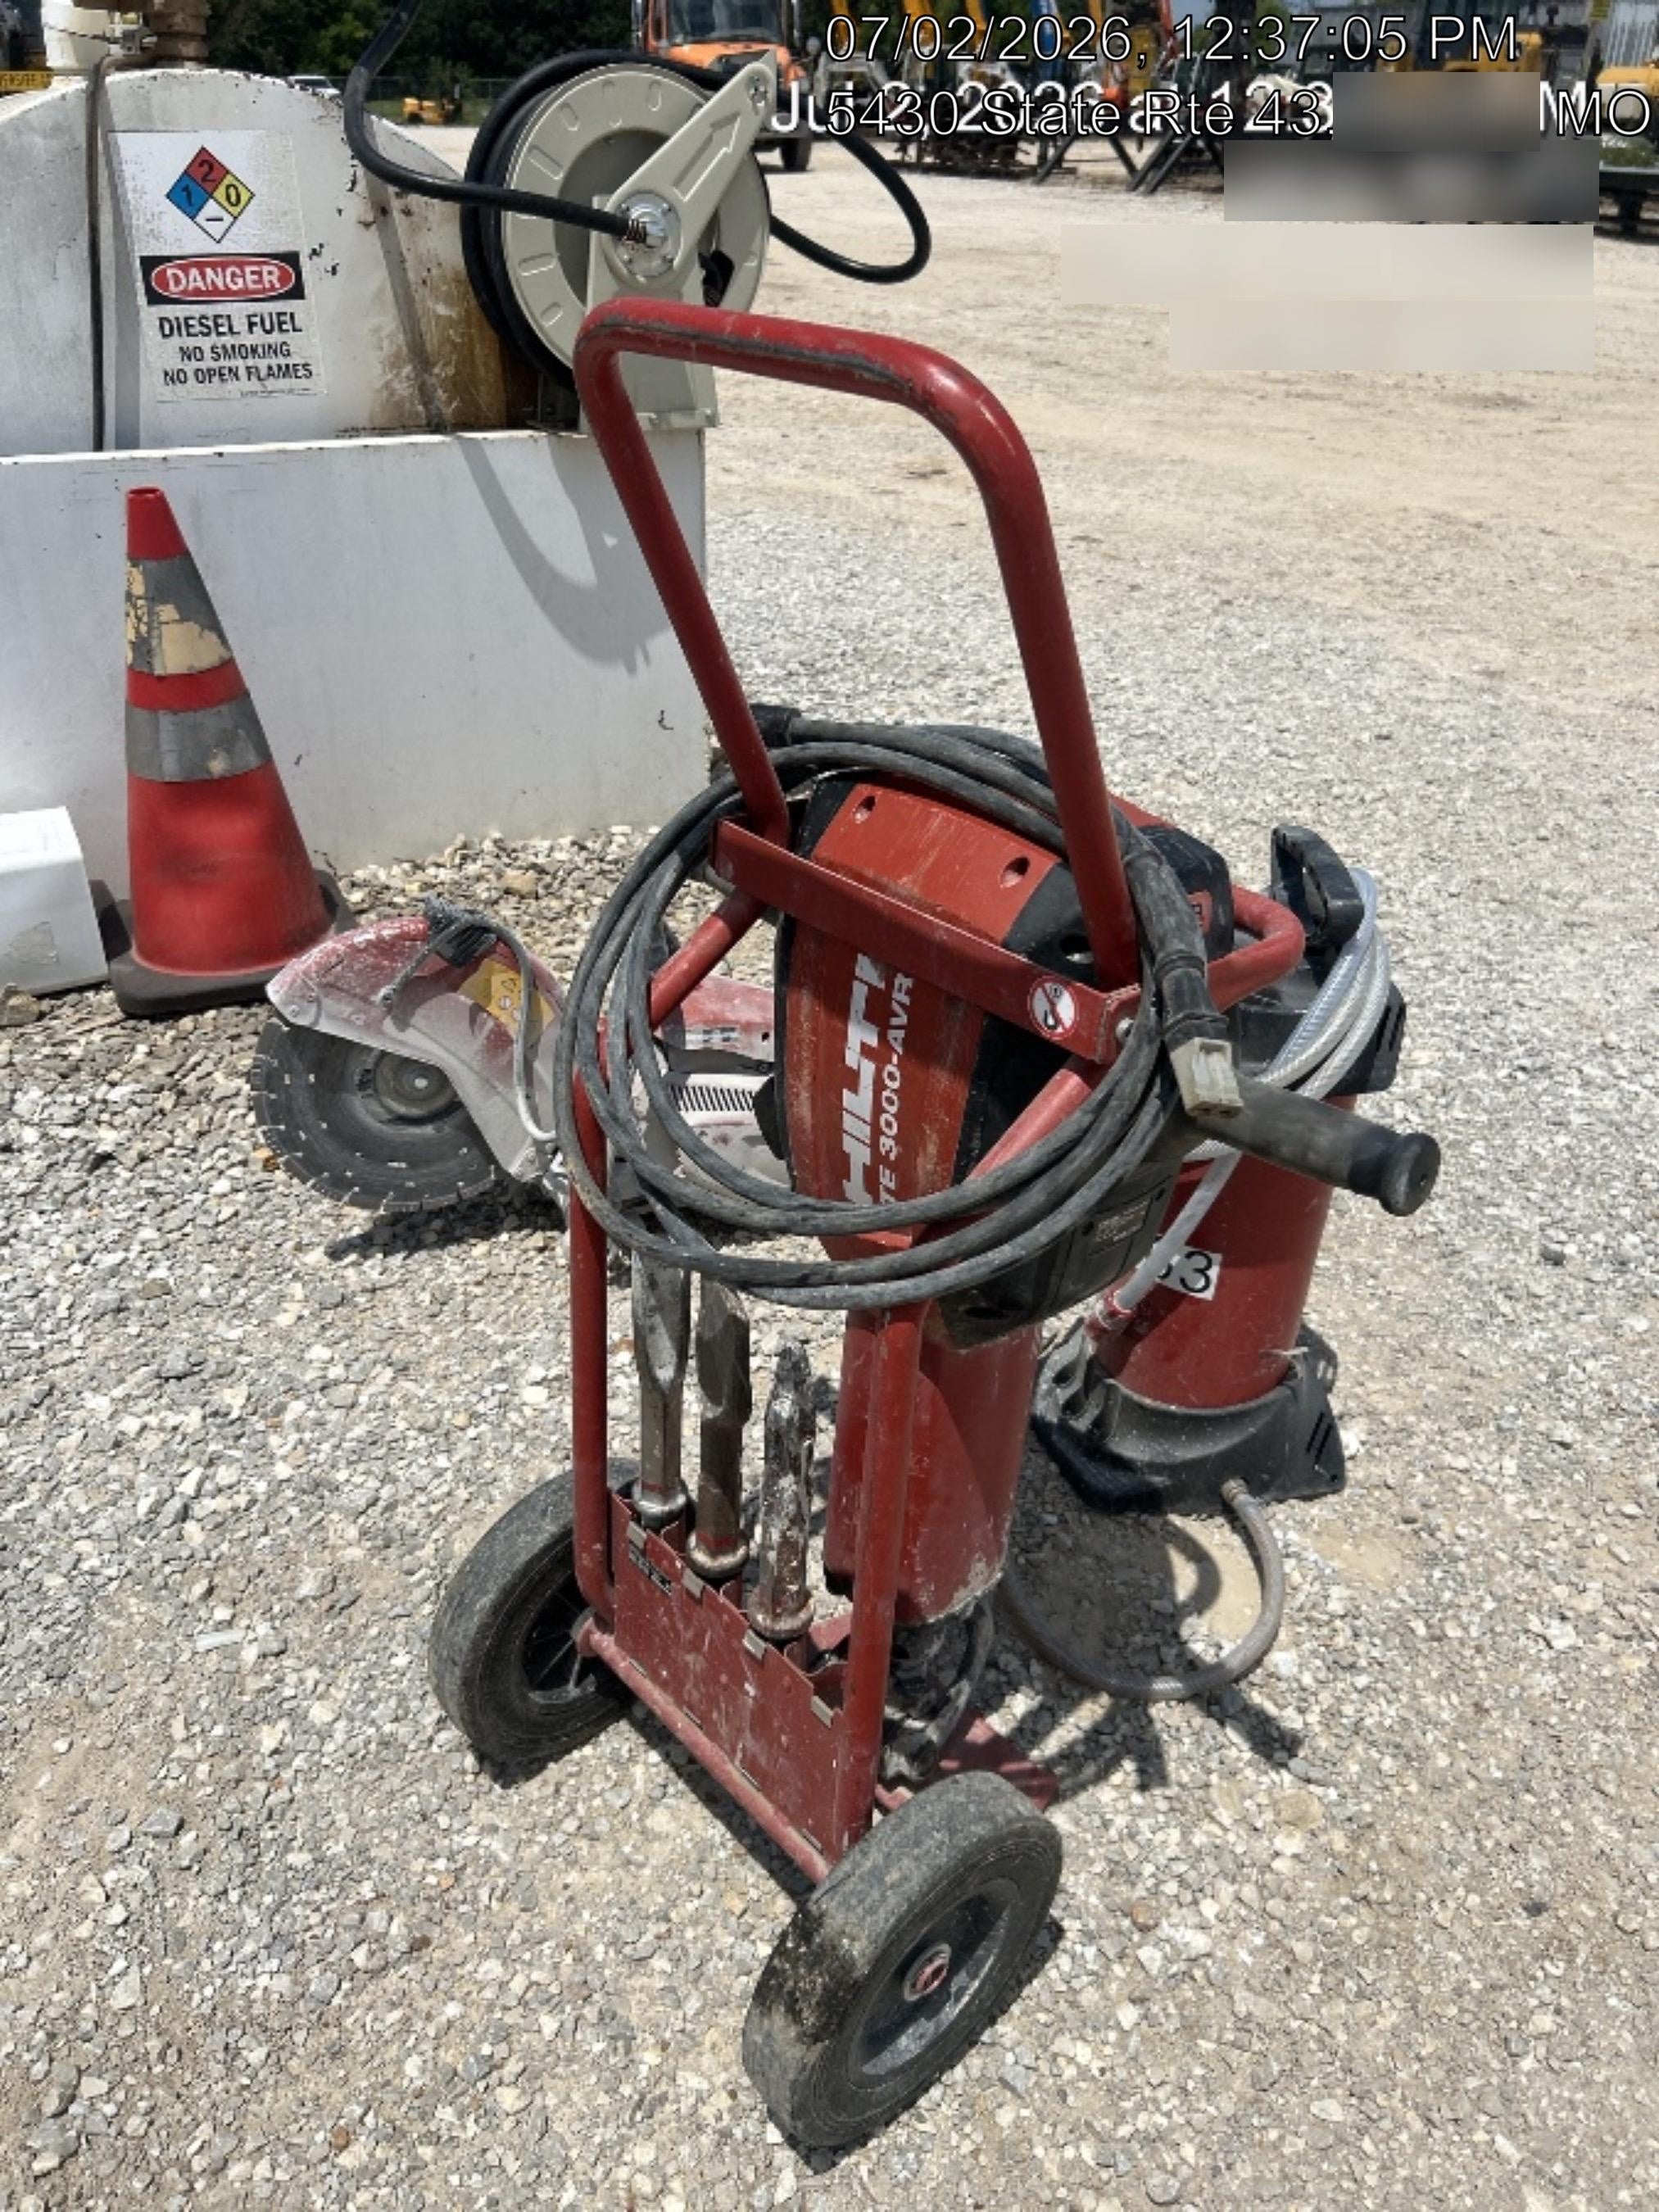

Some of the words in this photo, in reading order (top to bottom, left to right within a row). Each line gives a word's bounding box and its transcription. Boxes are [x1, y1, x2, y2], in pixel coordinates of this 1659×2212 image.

[200, 160, 216, 183] 2
[181, 185, 193, 206] 1
[225, 184, 241, 206] 0
[165, 265, 281, 292] DANGER
[159, 314, 240, 338] DIESEL
[246, 312, 303, 334] FUEL
[179, 346, 204, 361] NO
[211, 342, 291, 360] SMOKING
[164, 368, 188, 386] NO
[195, 366, 239, 384] OPEN
[245, 363, 312, 381] FLAMES
[880, 972, 913, 1161] 3000-AVR
[842, 953, 885, 1205] HILTI
